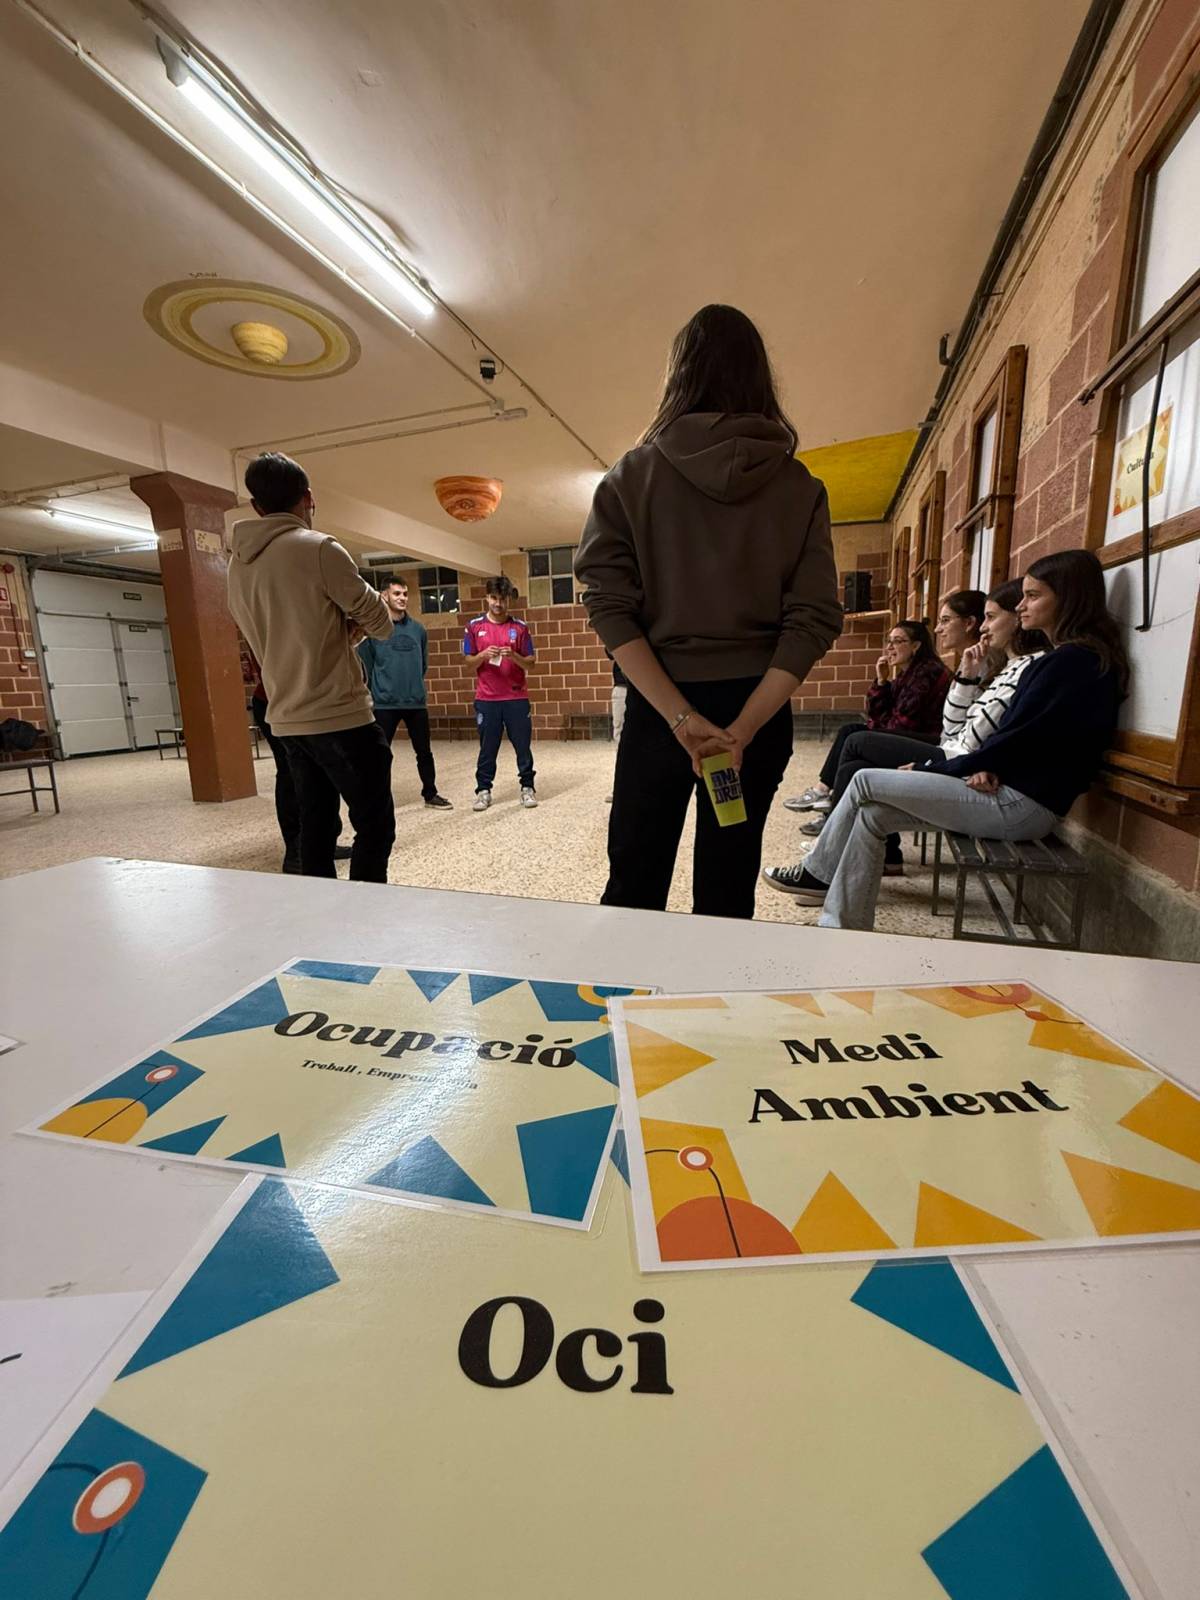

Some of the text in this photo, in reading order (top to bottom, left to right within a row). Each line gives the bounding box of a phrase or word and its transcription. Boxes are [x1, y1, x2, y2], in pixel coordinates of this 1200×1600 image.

[273, 1010, 577, 1068] Ocupació
[781, 1033, 942, 1065] Medi
[748, 1080, 1069, 1124] Ambient
[457, 1296, 675, 1395] Oci
